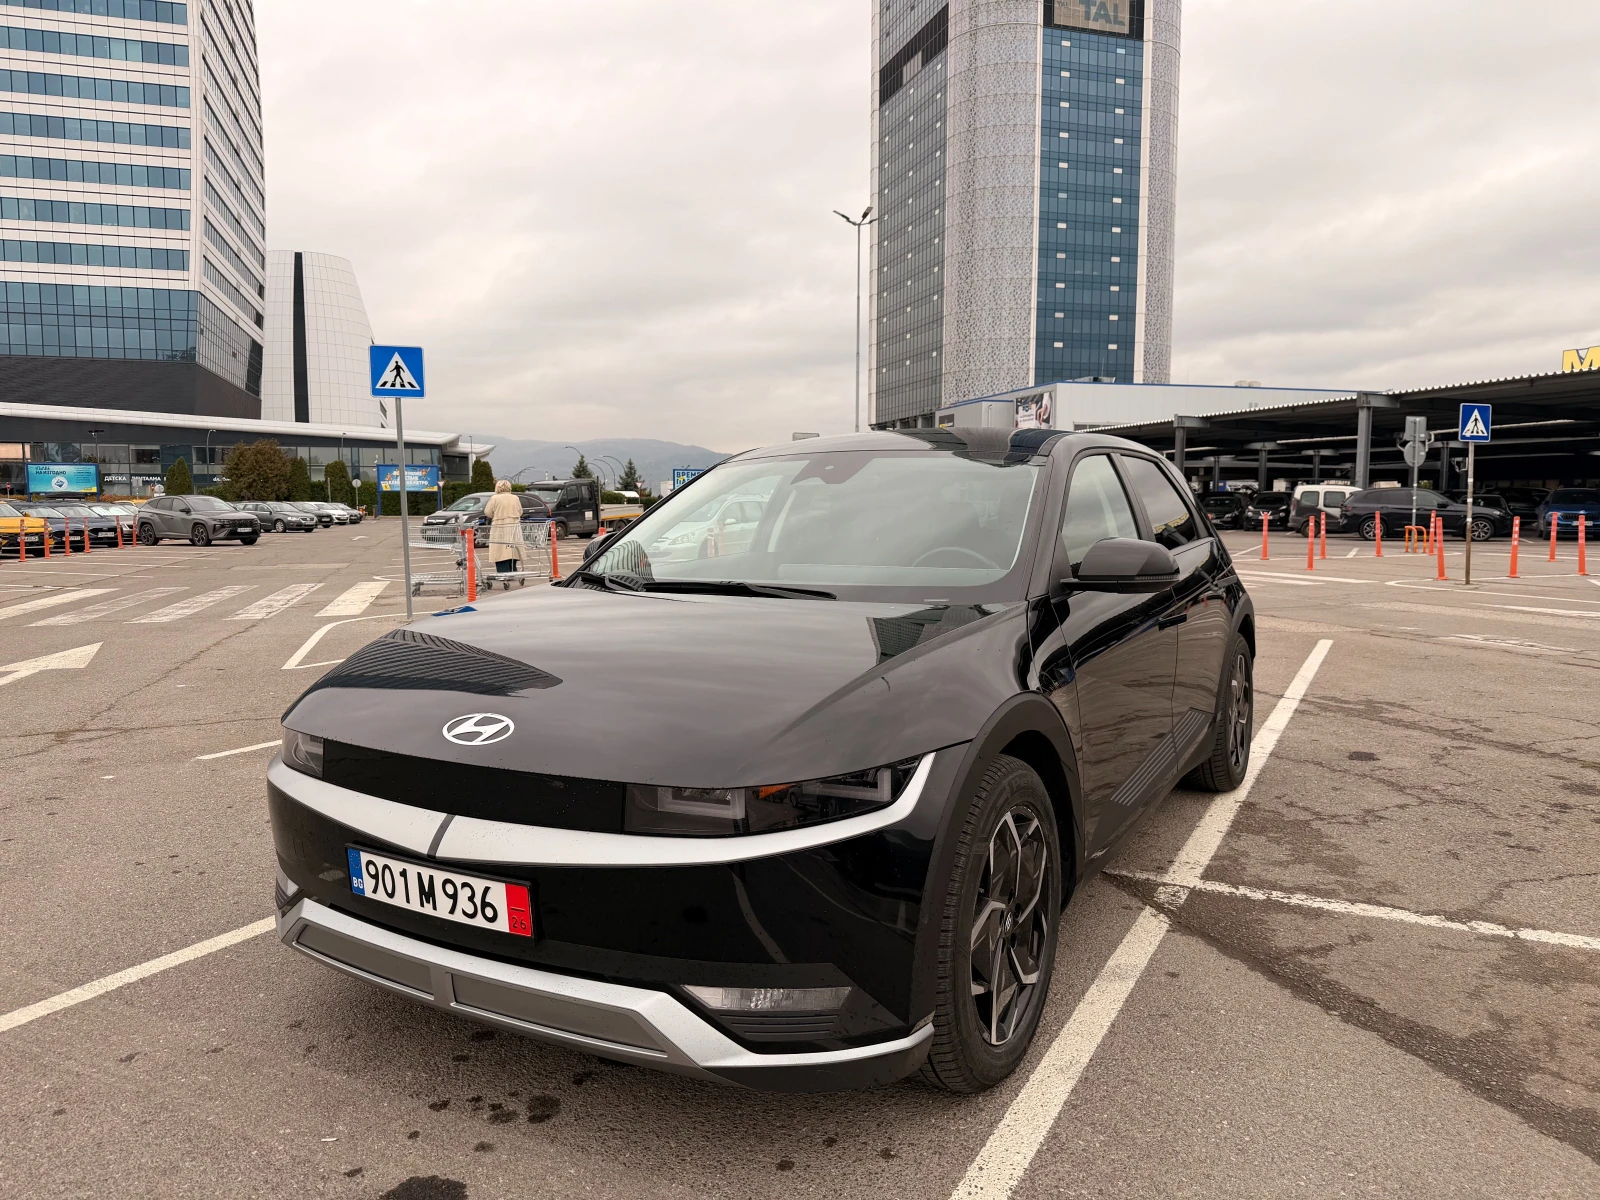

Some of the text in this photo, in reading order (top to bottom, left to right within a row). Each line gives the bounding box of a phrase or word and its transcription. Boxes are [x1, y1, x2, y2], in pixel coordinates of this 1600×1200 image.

[1079, 0, 1126, 26] TAL
[353, 877, 364, 889] BG
[512, 916, 527, 930] 26
